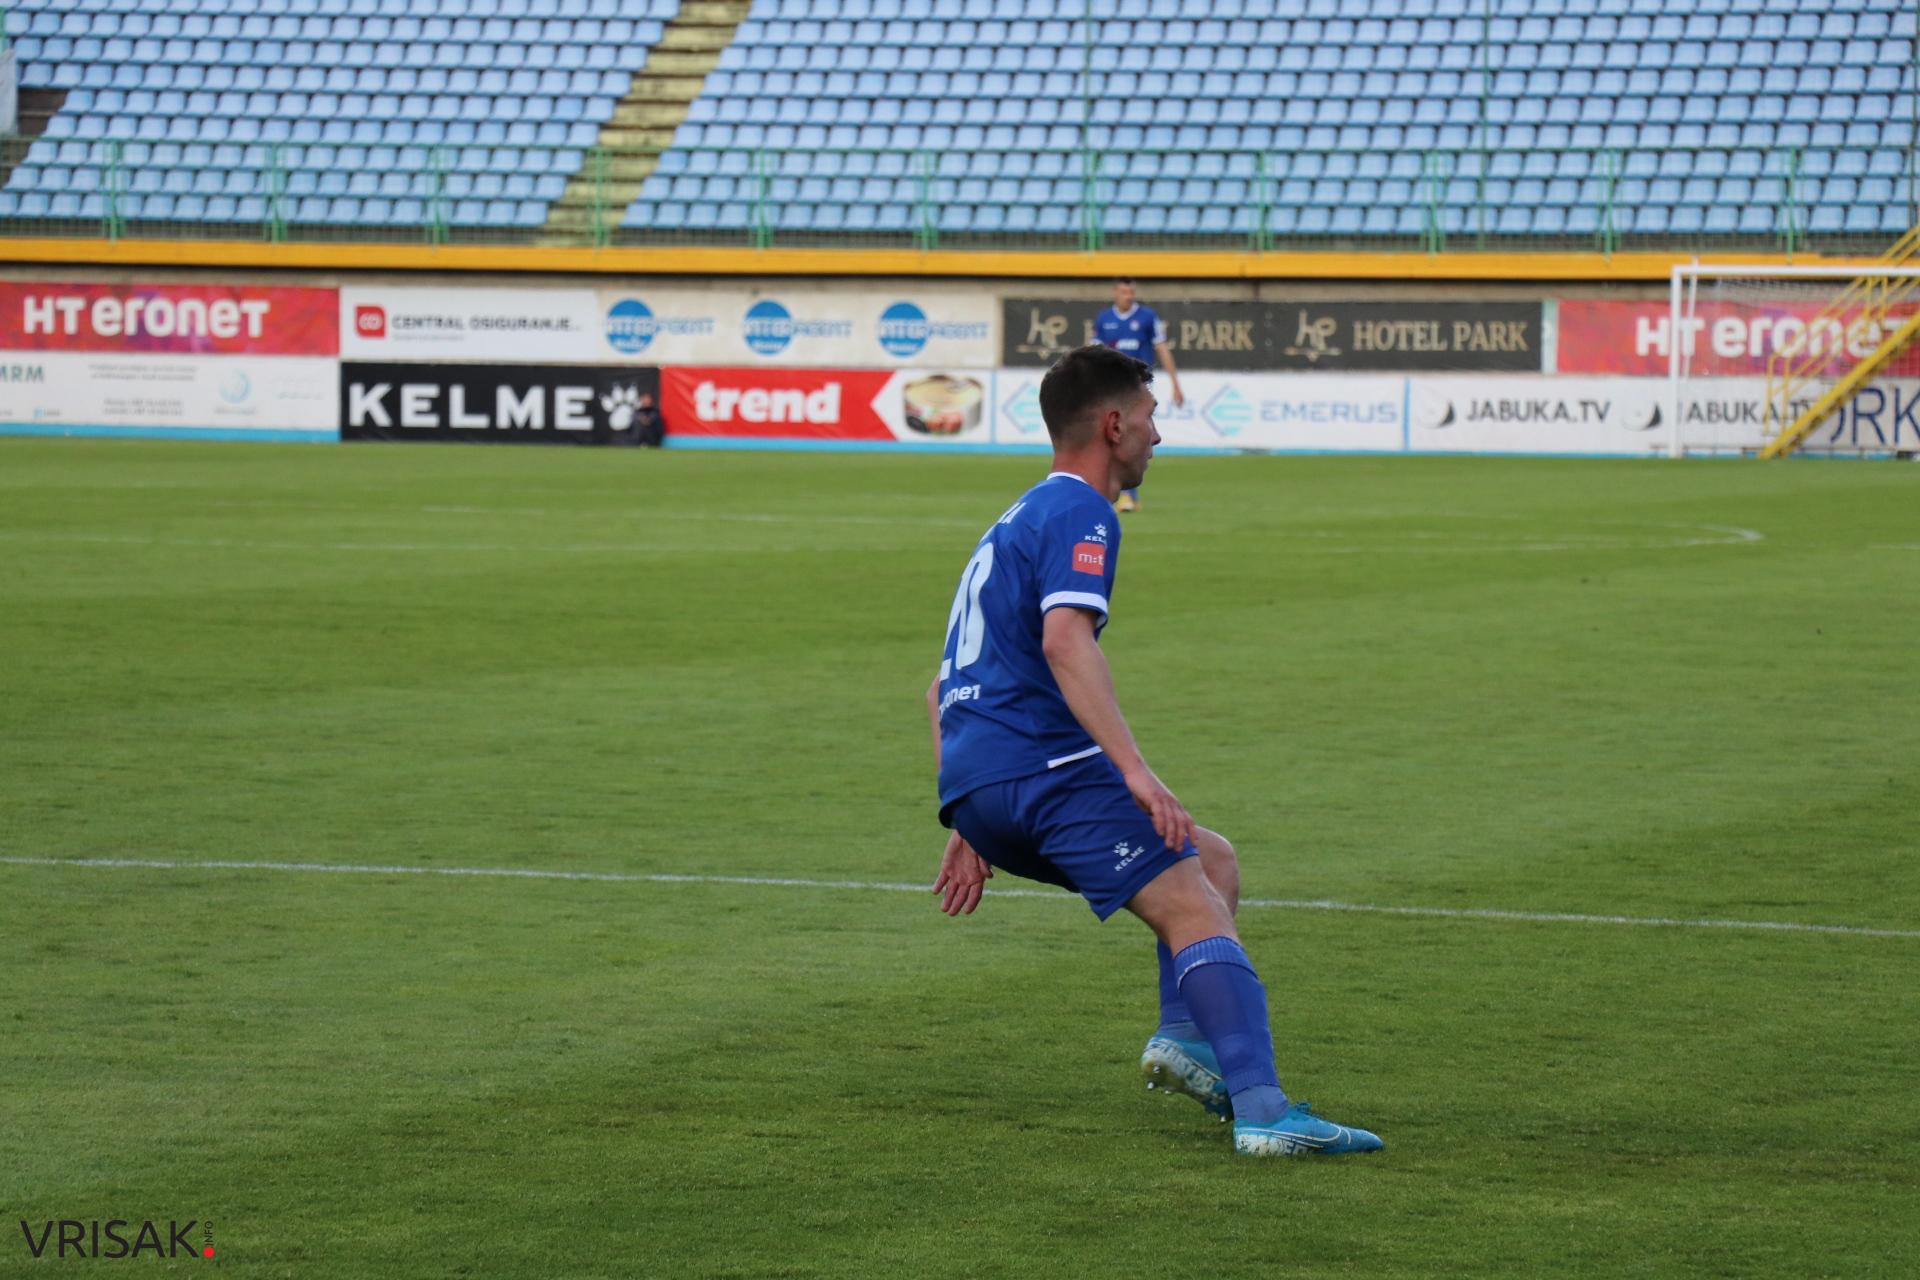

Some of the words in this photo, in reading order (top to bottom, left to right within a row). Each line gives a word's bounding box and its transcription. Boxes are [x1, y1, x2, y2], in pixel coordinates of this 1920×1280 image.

[23, 295, 85, 335] HT
[392, 314, 465, 330] CENTRAL
[470, 316, 572, 332] OSIGURANJE
[1180, 319, 1254, 350] PARK
[1353, 320, 1447, 350] HOTEL
[1453, 321, 1528, 350] PARK
[349, 382, 594, 430] KELME
[693, 381, 842, 423] trend
[1260, 401, 1398, 423] EMERUS
[1466, 400, 1611, 423] JABUKA.TV
